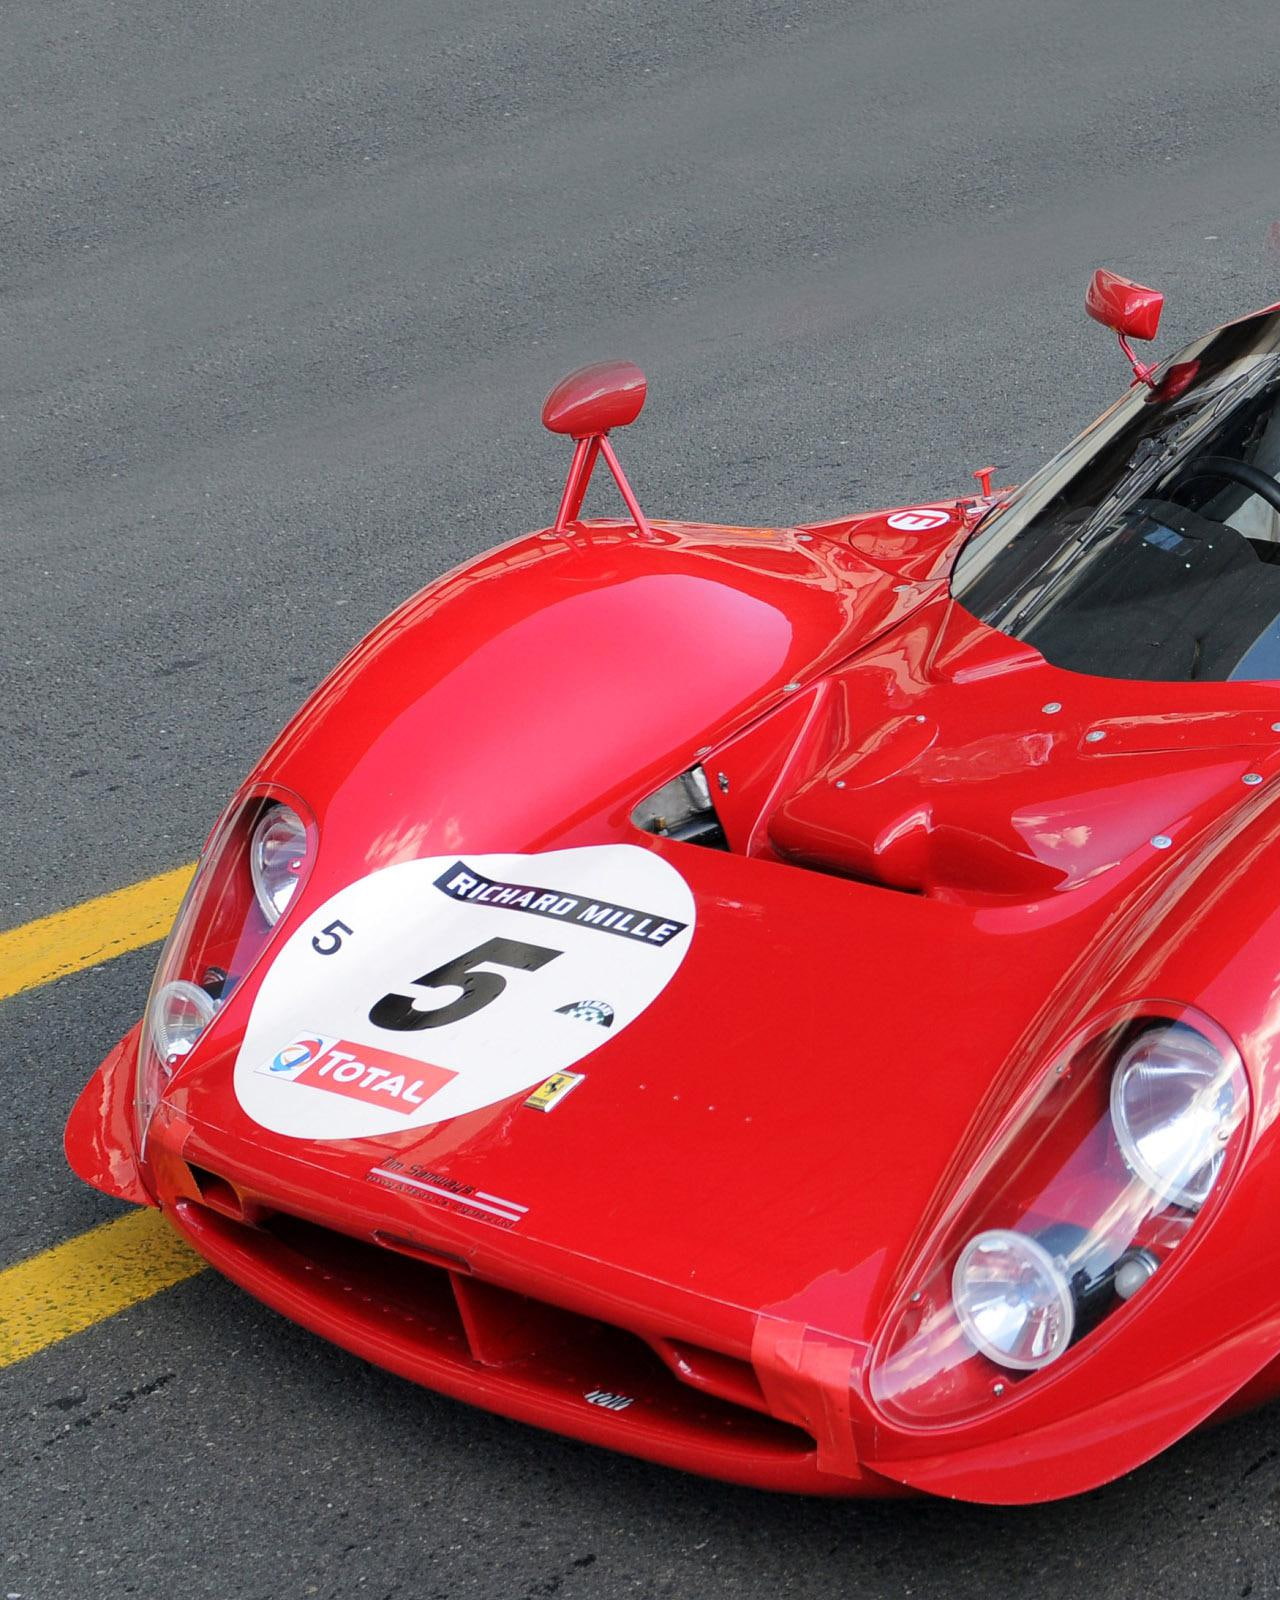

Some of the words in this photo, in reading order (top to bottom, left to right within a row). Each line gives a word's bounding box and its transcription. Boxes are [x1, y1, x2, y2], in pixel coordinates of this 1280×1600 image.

[311, 919, 354, 956] 5
[446, 871, 570, 917] RICHARD
[577, 903, 679, 943] MILLE
[368, 936, 565, 1032] 5
[317, 1049, 426, 1105] TOTAL
